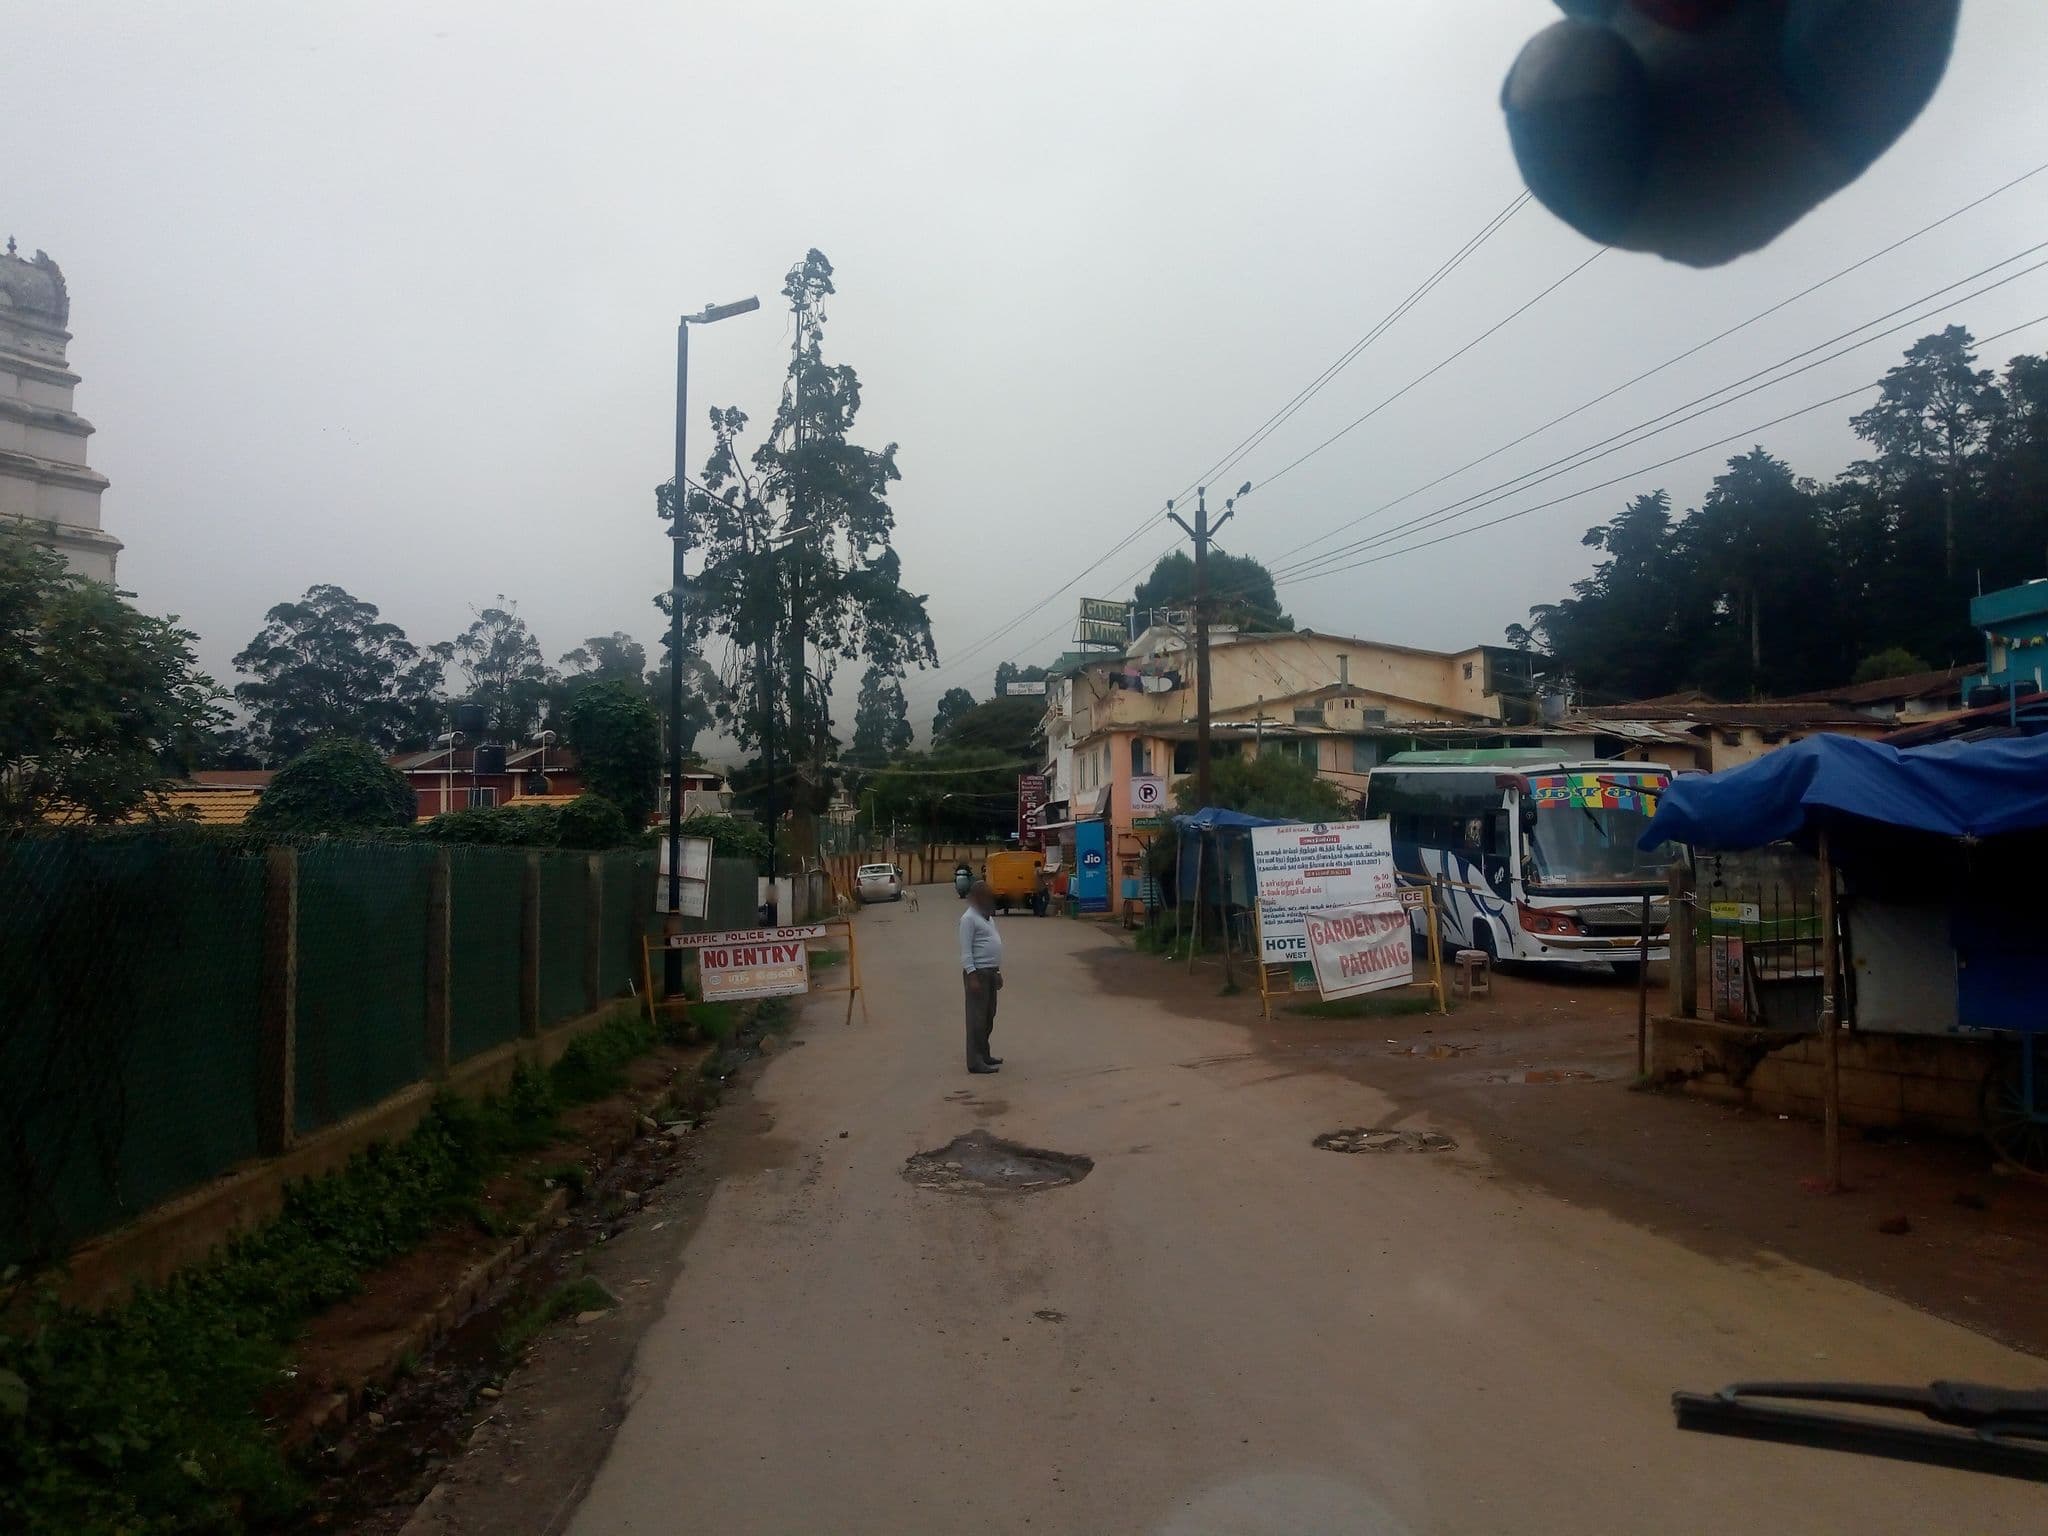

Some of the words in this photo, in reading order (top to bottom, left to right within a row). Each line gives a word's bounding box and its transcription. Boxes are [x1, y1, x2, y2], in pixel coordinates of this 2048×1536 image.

[1083, 853, 1101, 864] Jio
[1401, 892, 1422, 902] ICE
[676, 935, 717, 945] TRAFFIC
[777, 927, 817, 938] OOTY
[1311, 912, 1377, 946] GARDEN
[1265, 938, 1306, 951] HOTE
[703, 950, 729, 969] NO
[733, 944, 800, 967] ENTRY
[1339, 942, 1410, 978] PARKING
